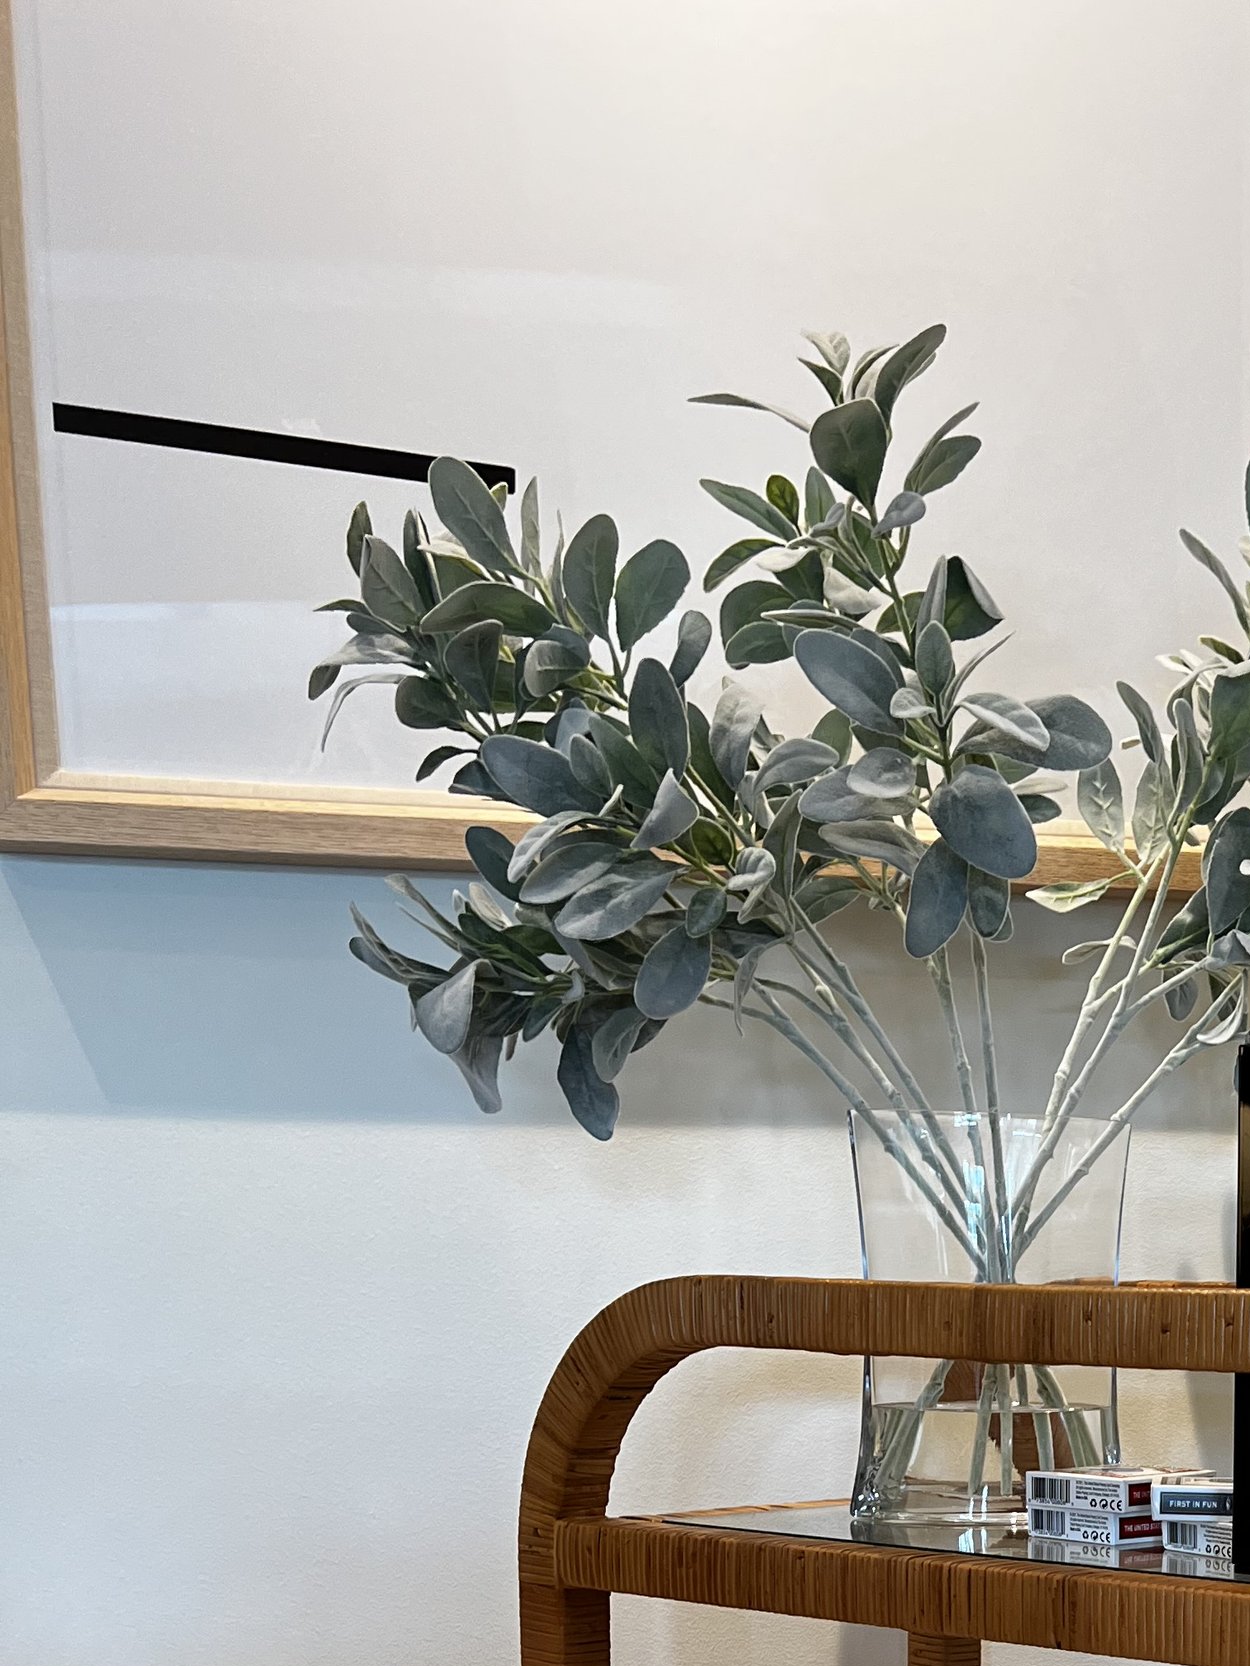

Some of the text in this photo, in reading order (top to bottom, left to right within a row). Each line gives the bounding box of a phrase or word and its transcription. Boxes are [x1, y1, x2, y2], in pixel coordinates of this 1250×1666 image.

[1169, 1500, 1218, 1509] FIRST IN FUN
[1124, 1524, 1134, 1533] THE
[1134, 1523, 1150, 1532] UNITED
